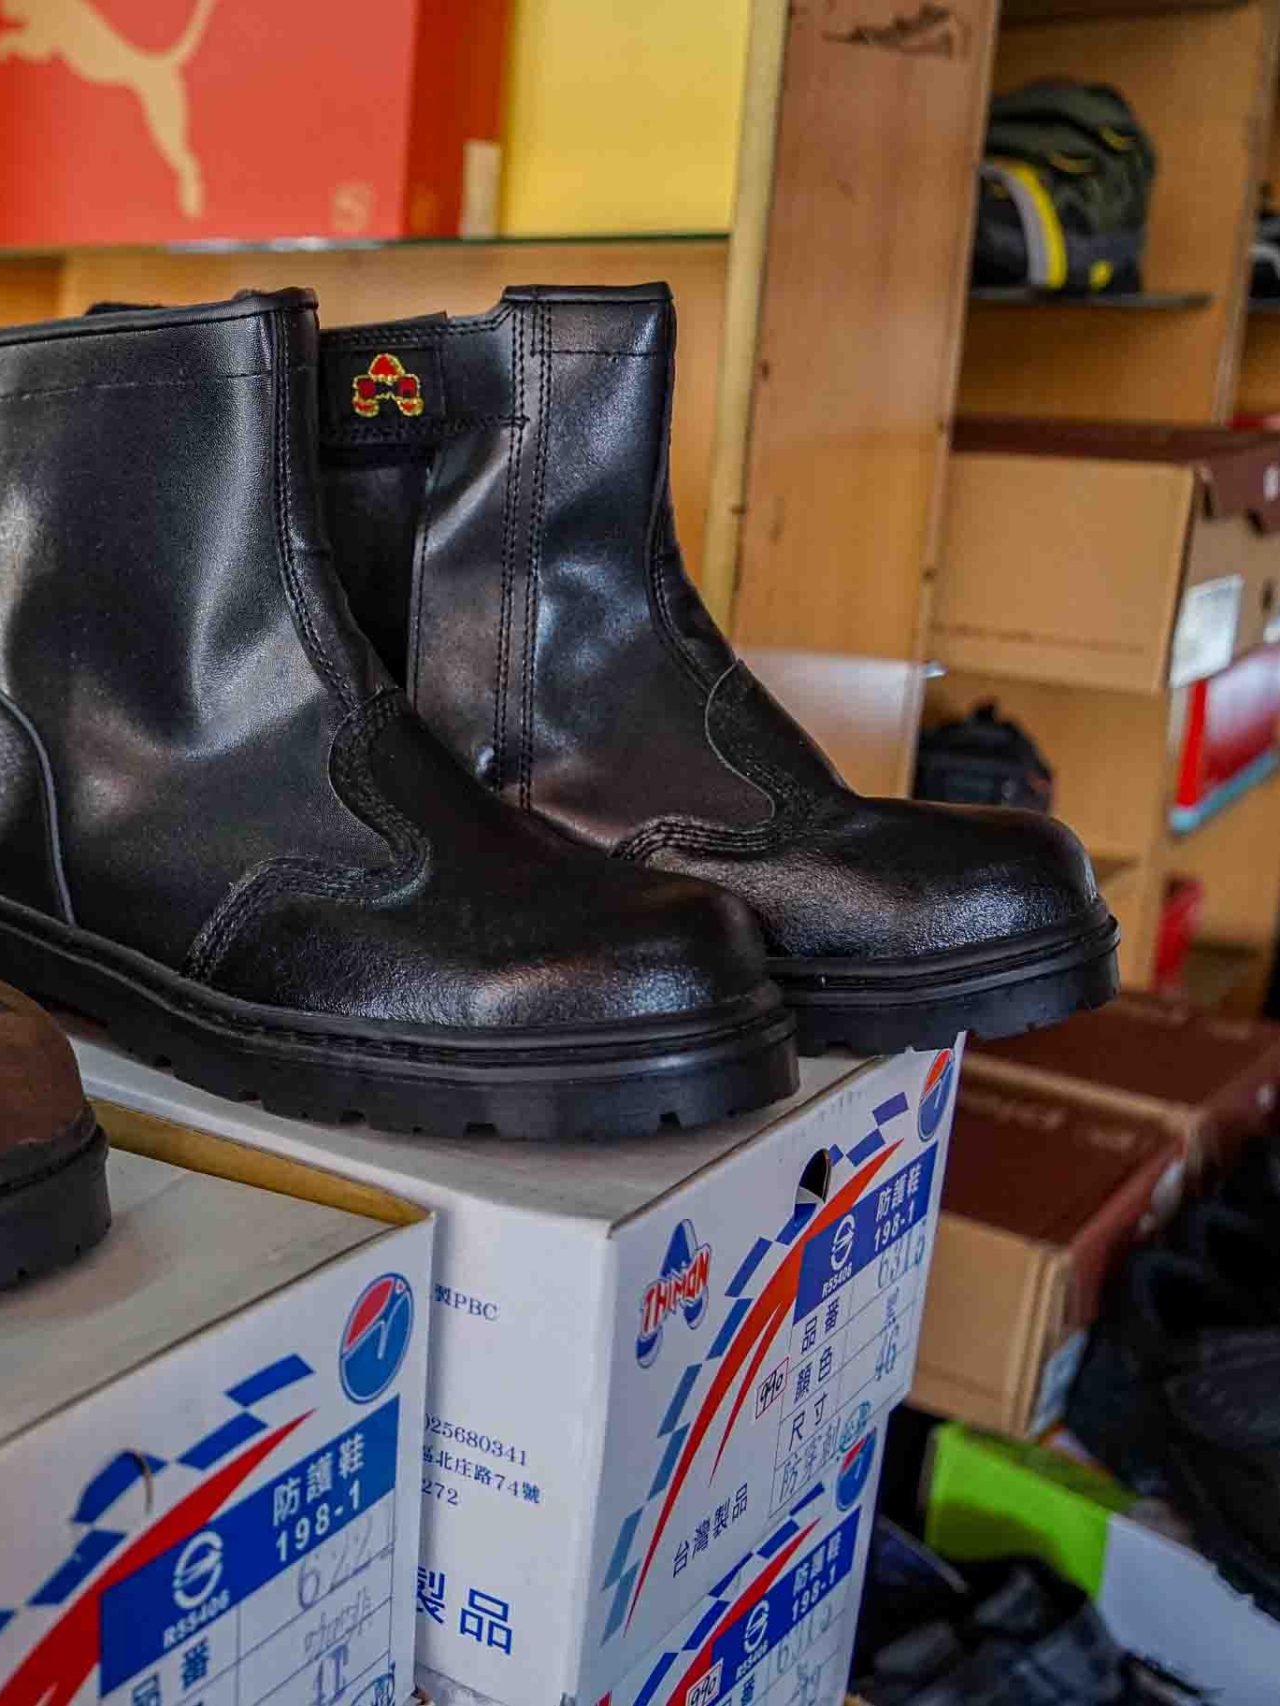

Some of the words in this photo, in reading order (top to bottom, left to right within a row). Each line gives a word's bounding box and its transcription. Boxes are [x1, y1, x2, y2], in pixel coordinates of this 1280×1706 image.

[875, 1201, 915, 1252] 198-1
[876, 1163, 922, 1222] 防護鞋
[789, 1392, 828, 1452] 尺寸
[273, 1432, 366, 1527] 防護鞋
[276, 1480, 361, 1562] 198-1
[673, 1482, 748, 1579] 台灣製品
